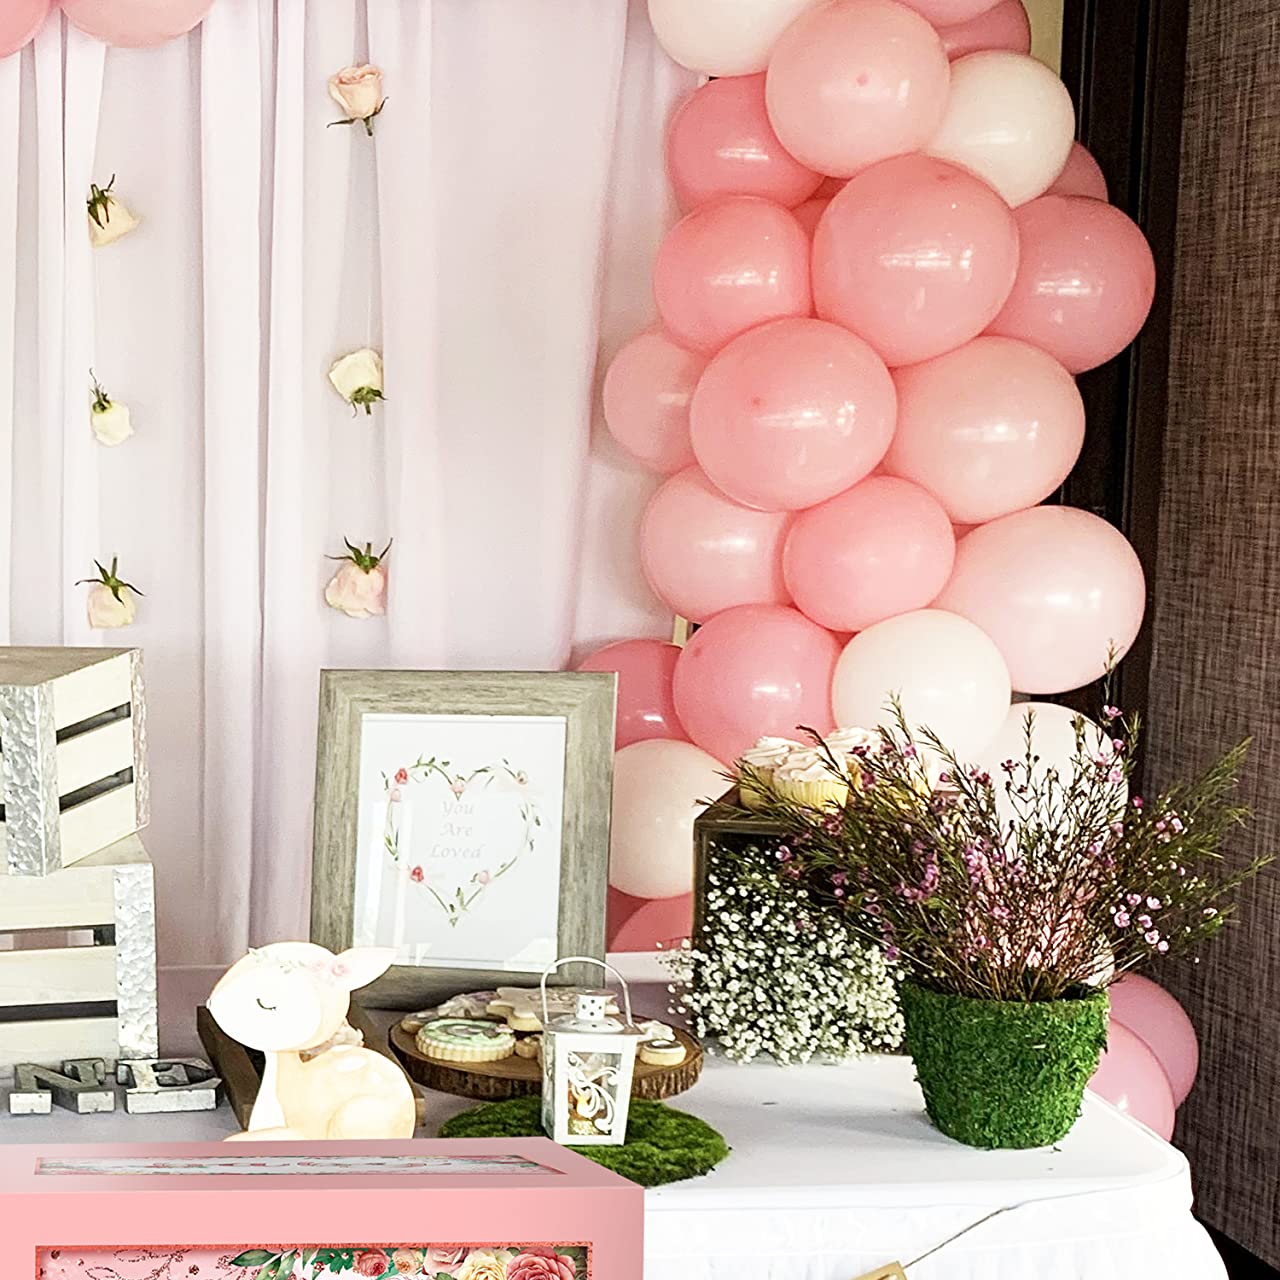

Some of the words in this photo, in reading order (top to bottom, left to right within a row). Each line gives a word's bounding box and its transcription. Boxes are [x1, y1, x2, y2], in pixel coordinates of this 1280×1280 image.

[441, 800, 474, 816] You
[439, 822, 473, 838] Are
[428, 842, 485, 859] Loved
